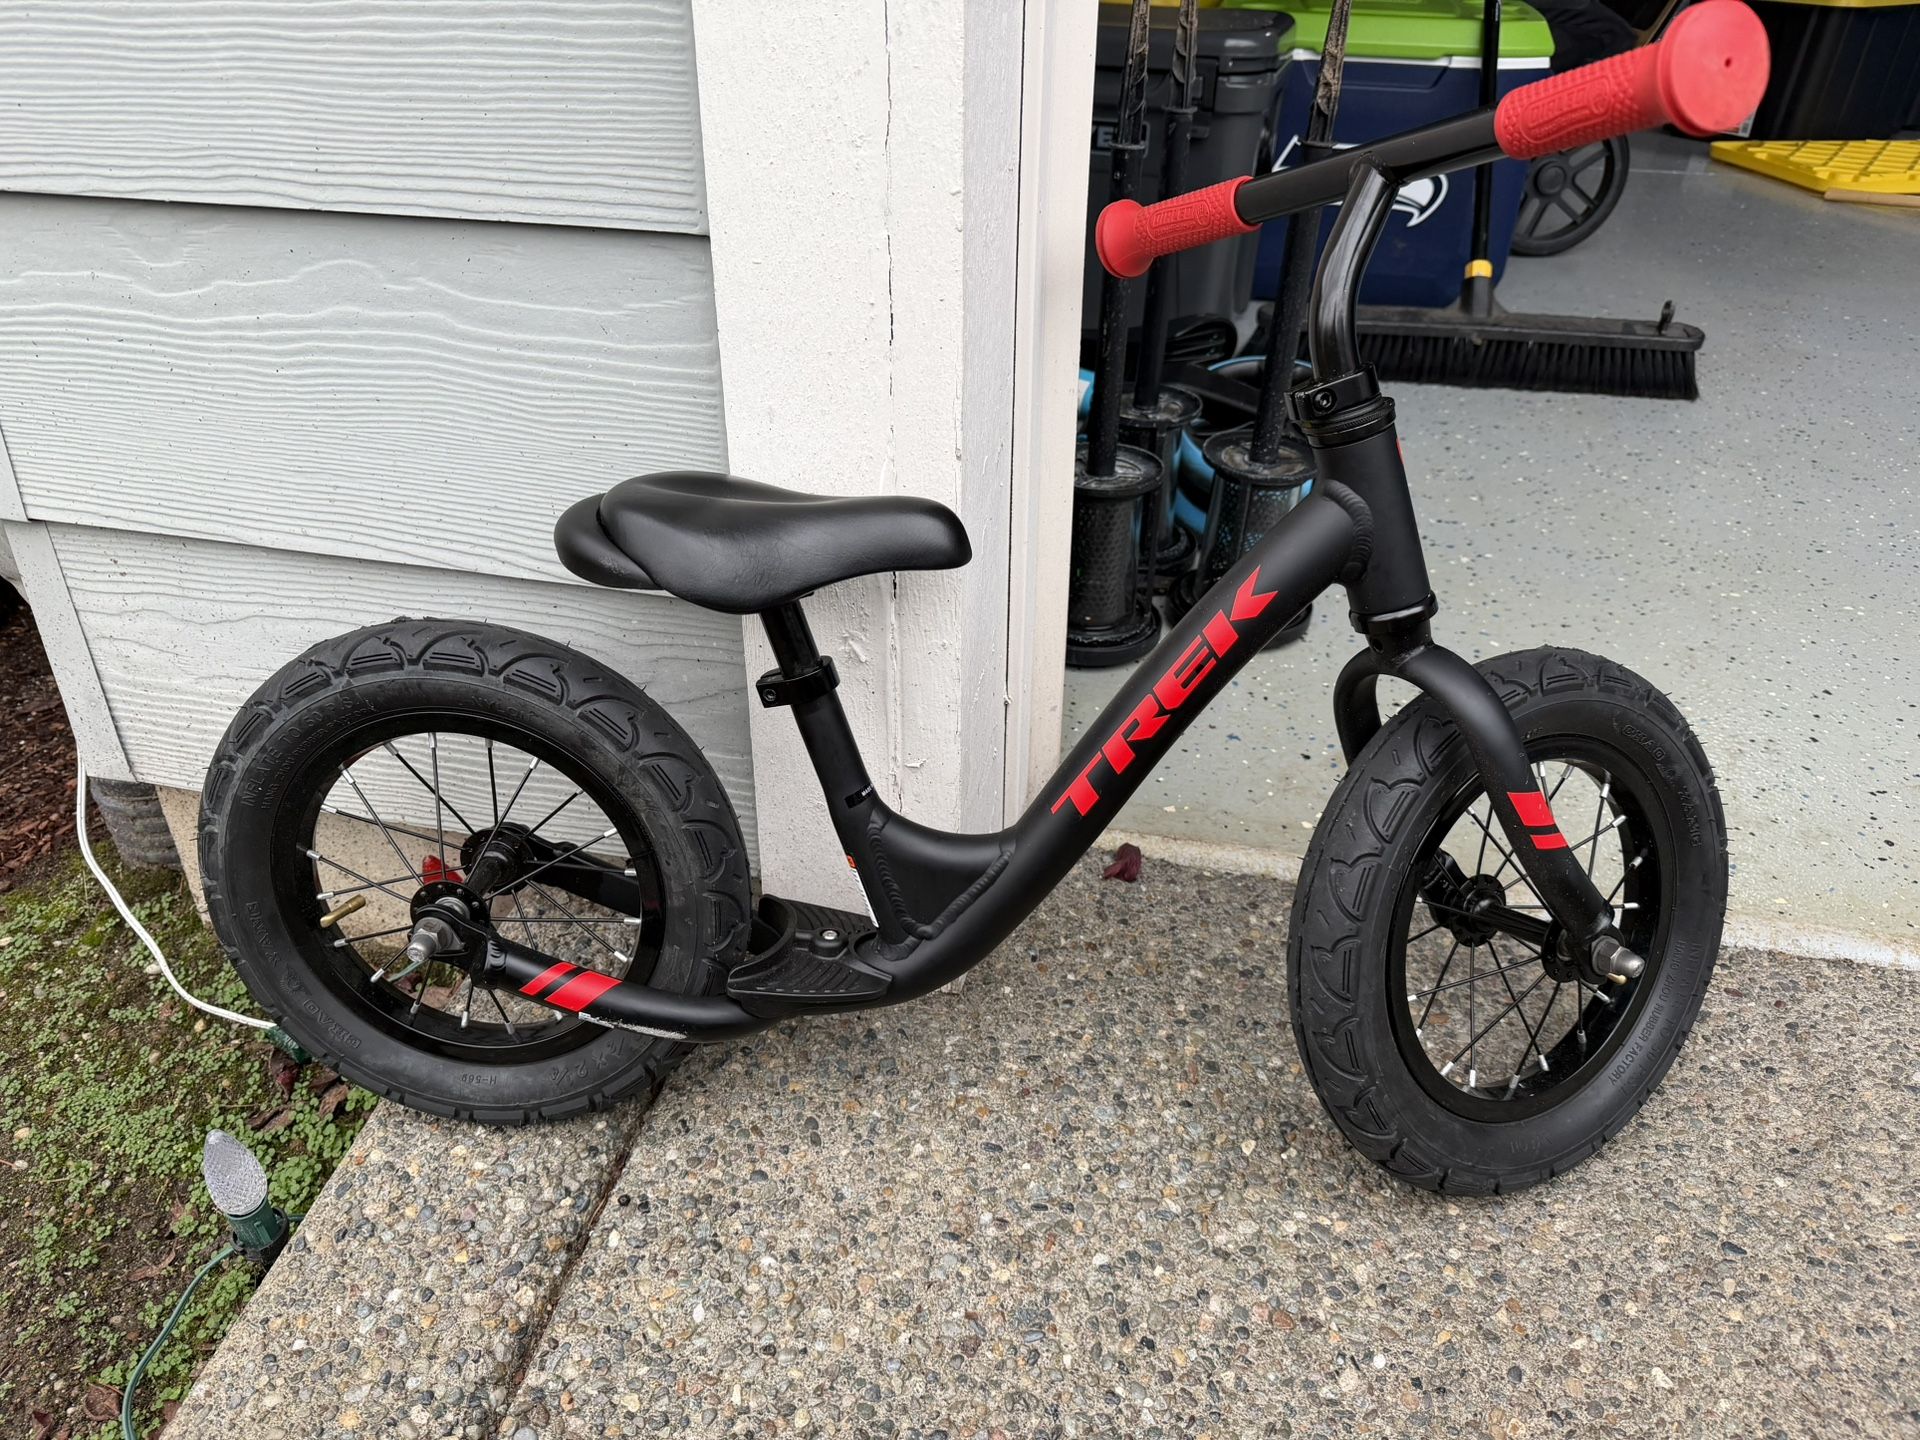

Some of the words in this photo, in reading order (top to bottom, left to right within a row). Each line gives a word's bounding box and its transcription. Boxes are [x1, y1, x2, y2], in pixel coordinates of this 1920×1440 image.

[1050, 564, 1279, 817] TREK
[279, 726, 302, 745] TO
[1671, 940, 1687, 970] HANG
[1659, 975, 1676, 1003] ZHOU
[1639, 1002, 1664, 1042] RUBBER
[1607, 1041, 1643, 1087] FACTORY
